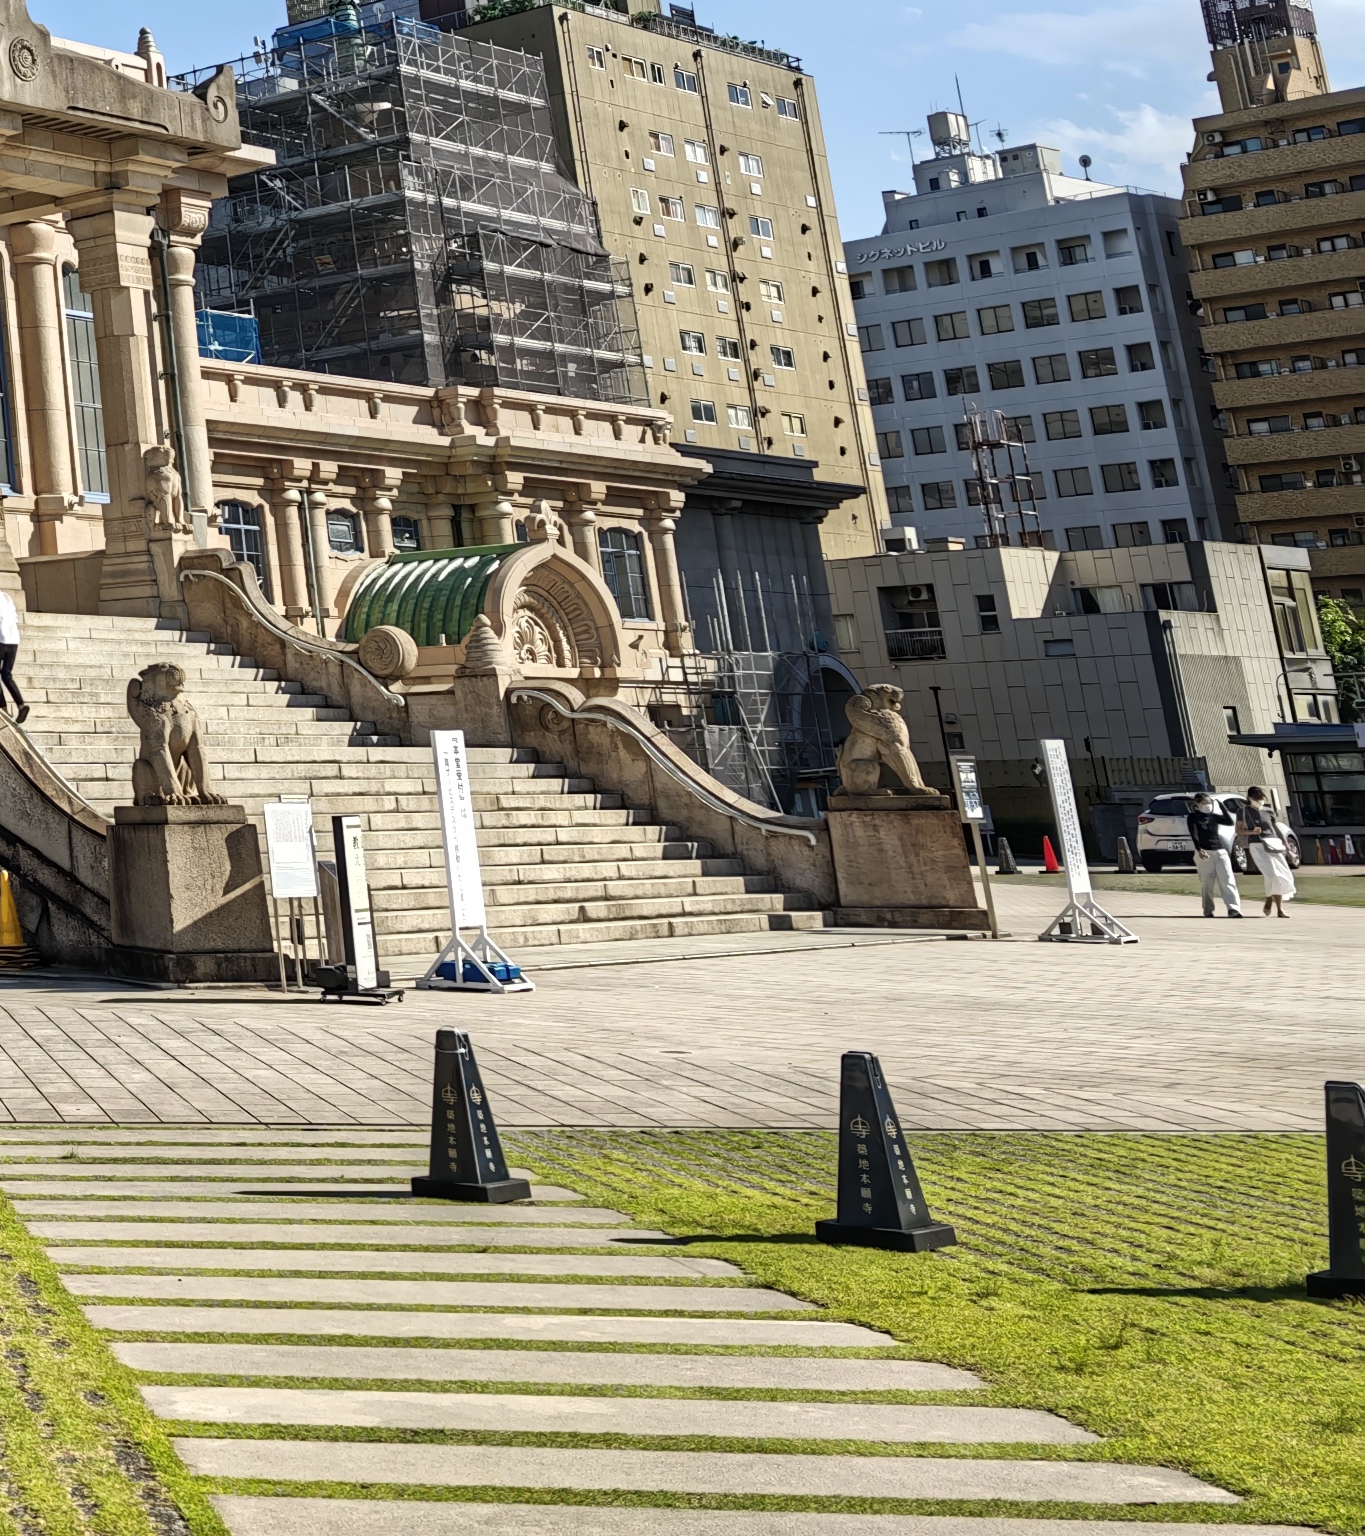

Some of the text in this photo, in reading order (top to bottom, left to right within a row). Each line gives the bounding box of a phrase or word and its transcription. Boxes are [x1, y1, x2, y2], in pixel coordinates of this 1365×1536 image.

[856, 239, 945, 264] シグネットビル
[857, 1144, 873, 1214] 築地本願寺
